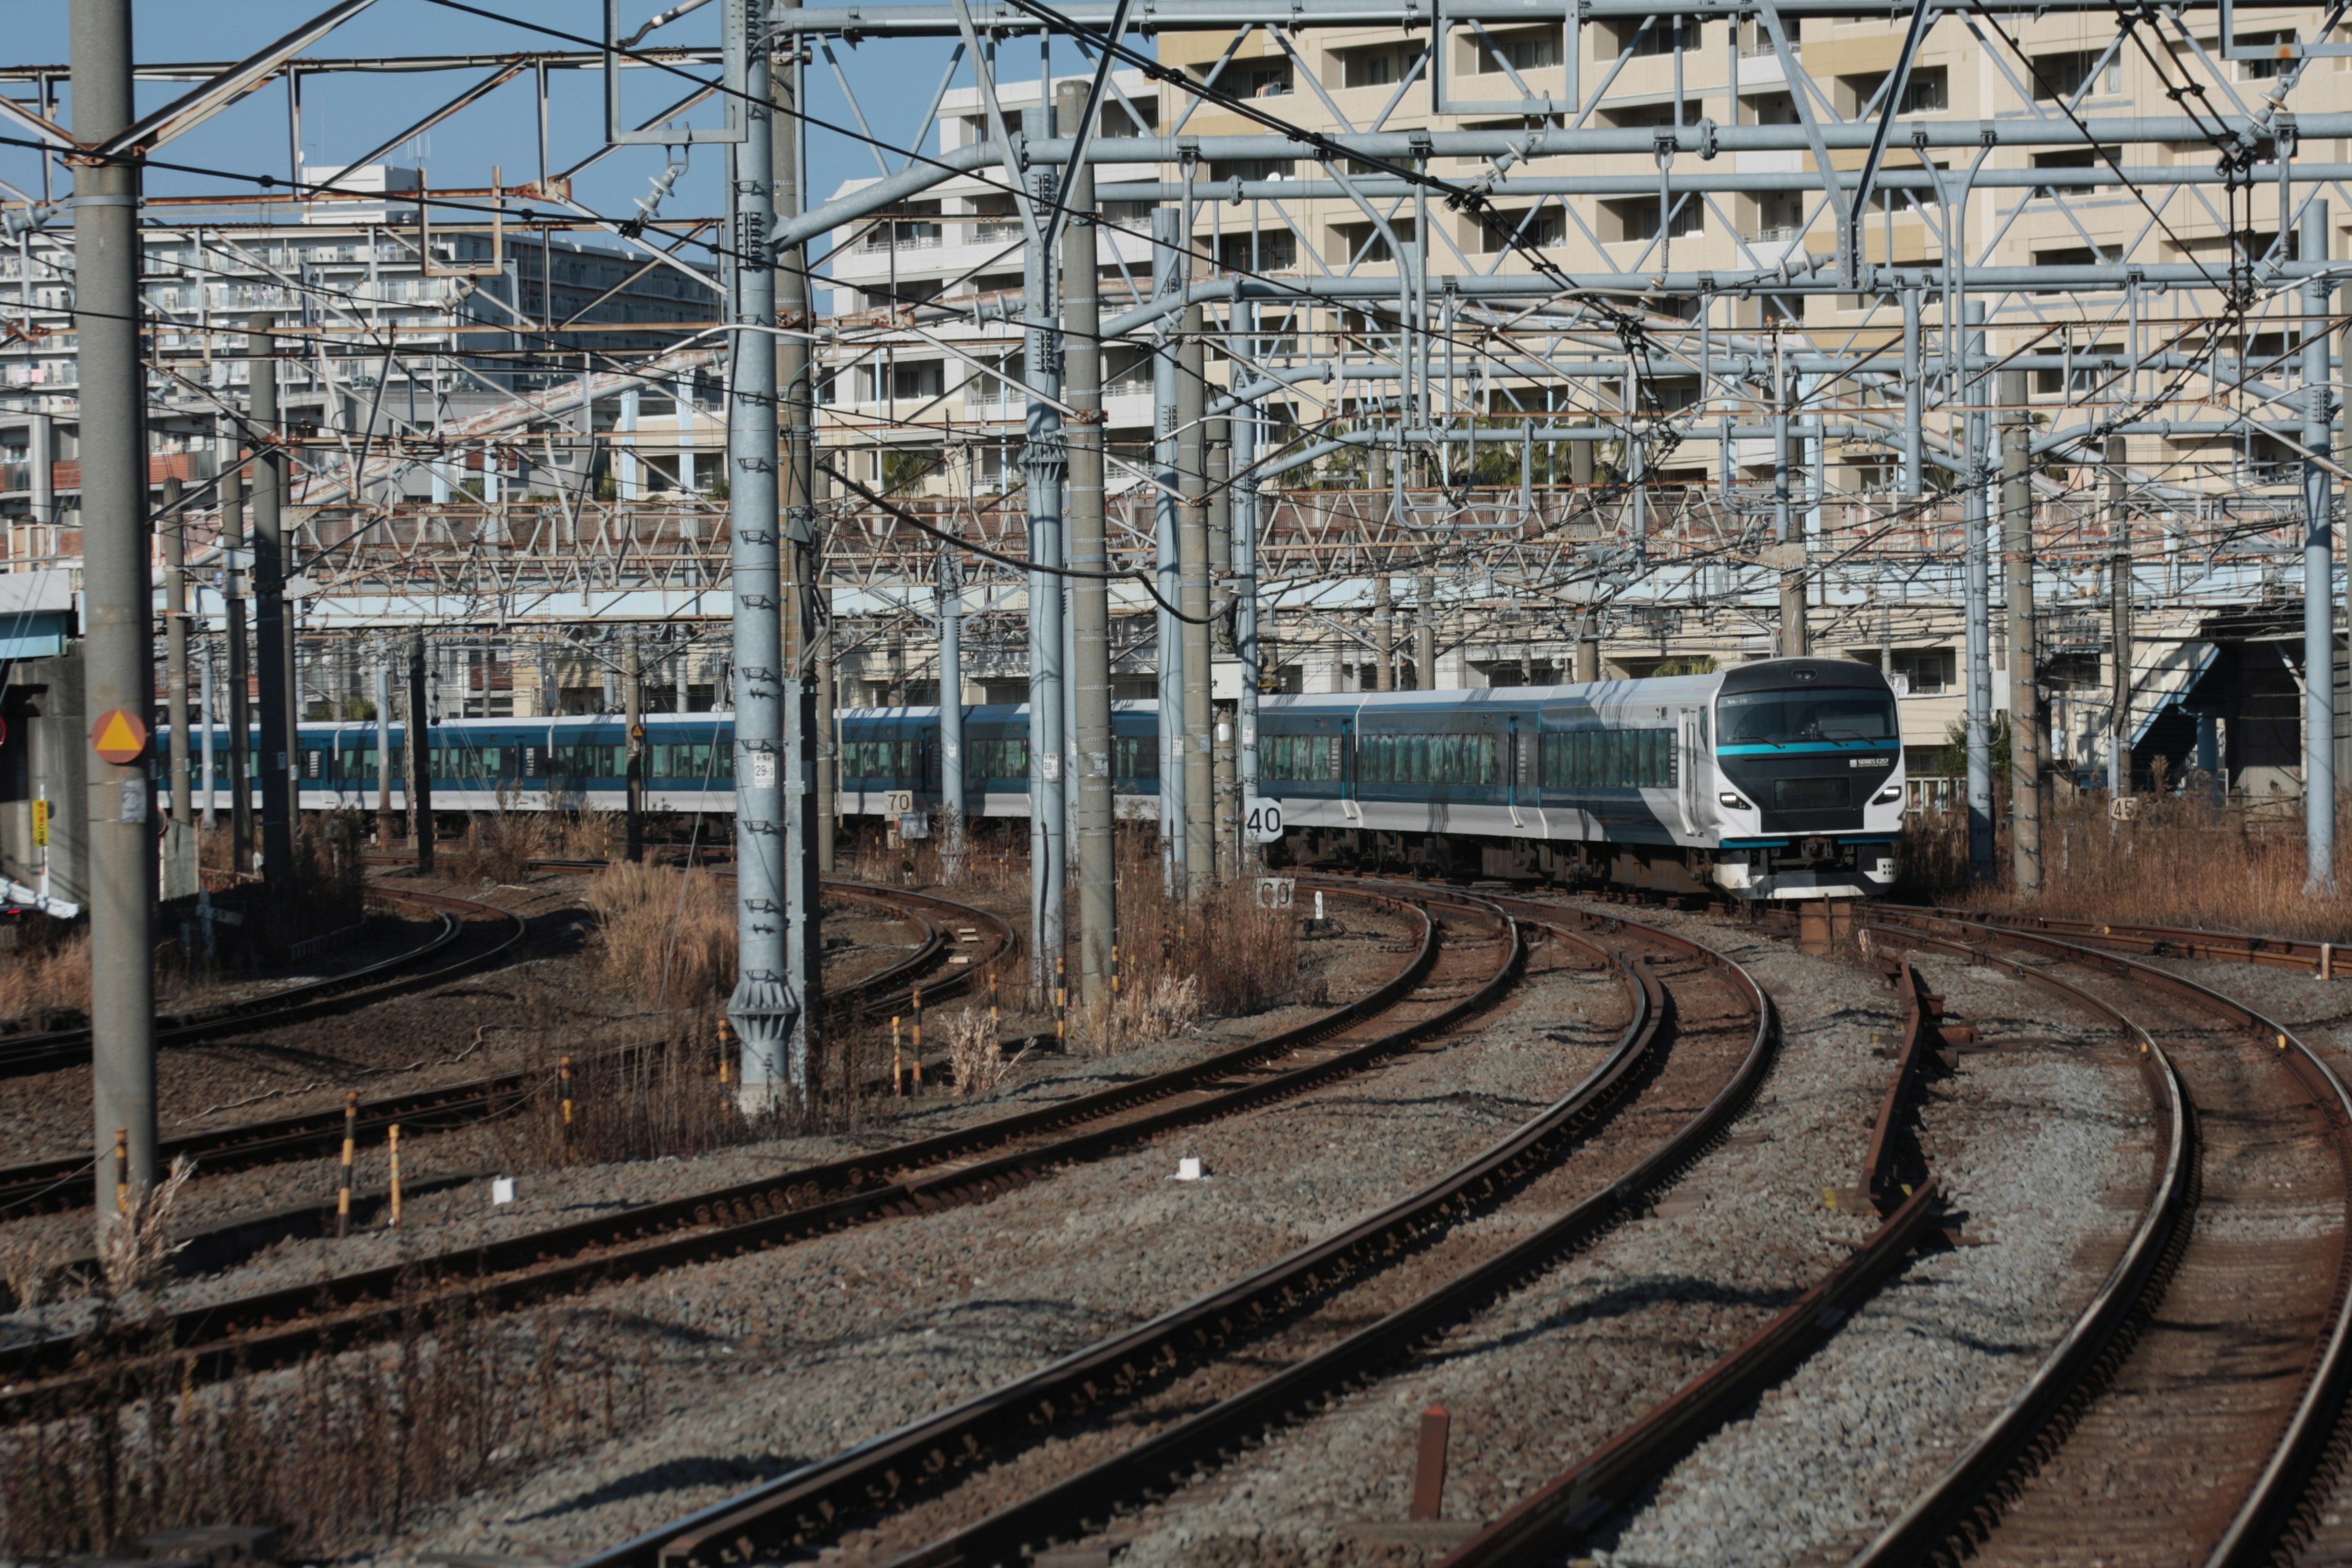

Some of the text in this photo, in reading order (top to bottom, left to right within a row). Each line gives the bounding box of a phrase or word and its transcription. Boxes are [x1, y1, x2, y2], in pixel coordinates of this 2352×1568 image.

[755, 765, 774, 776] 29-3
[888, 794, 909, 811] 70
[1247, 807, 1281, 833] 40
